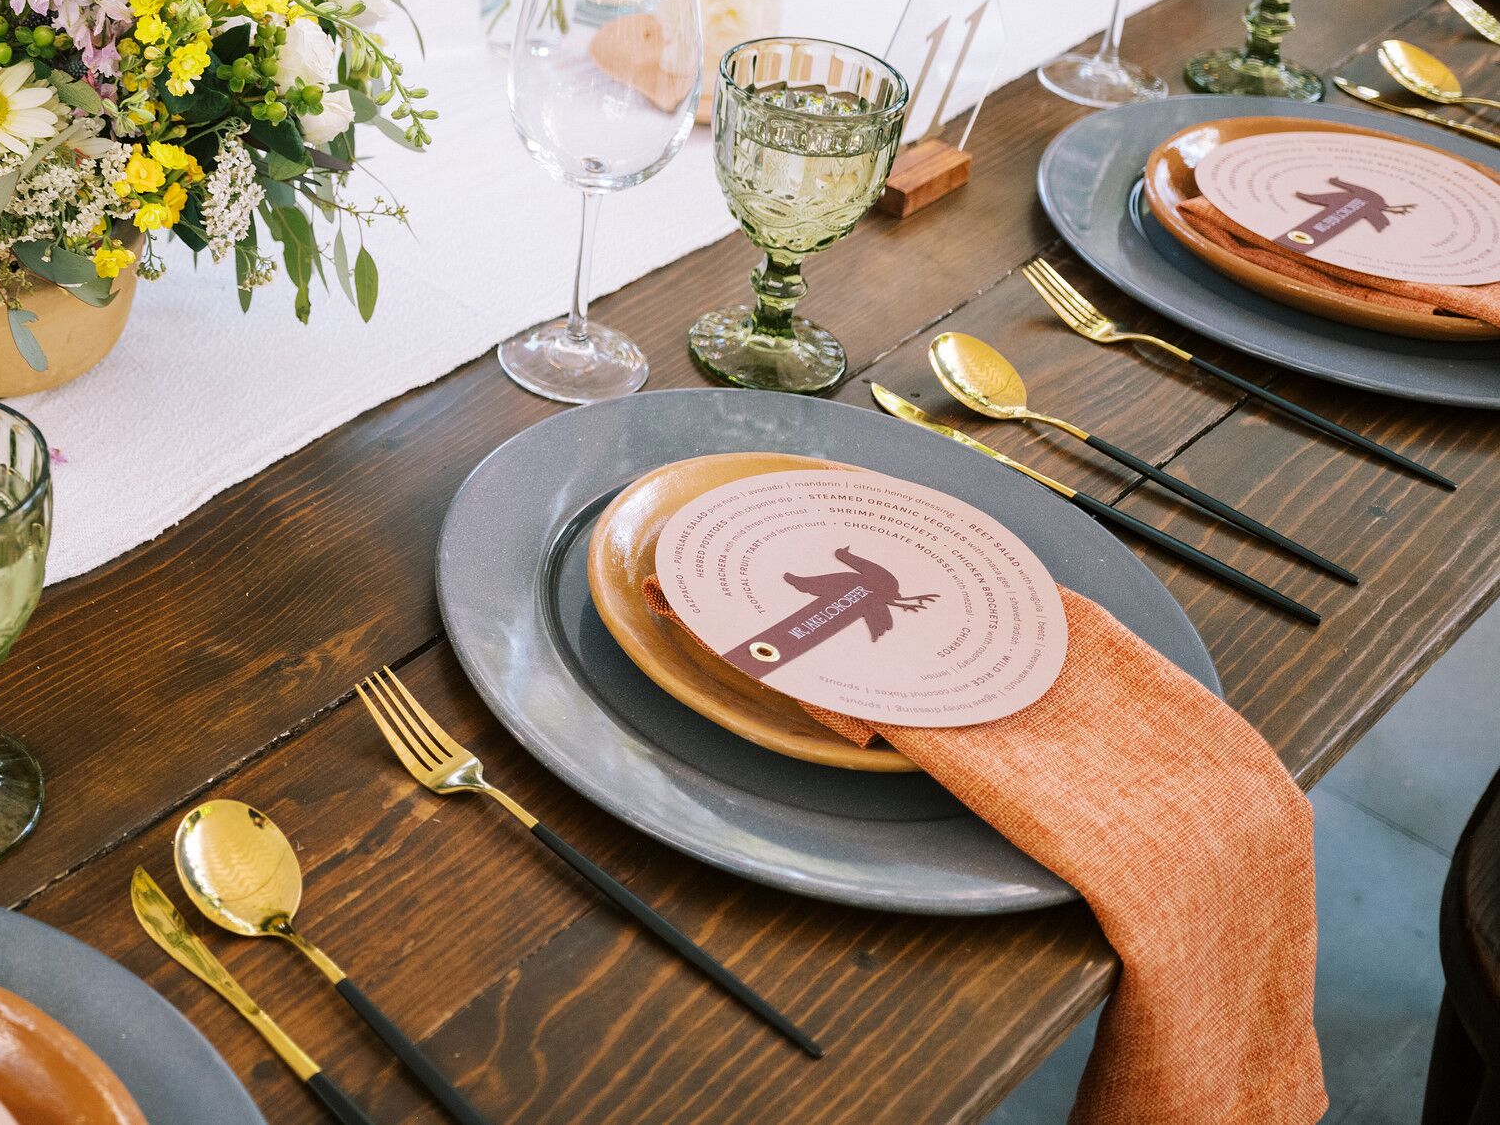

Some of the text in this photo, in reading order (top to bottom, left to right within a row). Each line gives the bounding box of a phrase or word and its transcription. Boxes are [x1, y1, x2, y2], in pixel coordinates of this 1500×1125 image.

[747, 484, 783, 496] avocado
[808, 493, 862, 502] STEAMED
[853, 483, 881, 493] citrus
[884, 488, 913, 502] honey
[722, 494, 740, 505] nuts
[867, 498, 920, 517] ORGANIC
[915, 497, 955, 519] dressing
[687, 511, 708, 530] SALAD
[785, 508, 808, 516] crust
[829, 507, 876, 518] SHRIMP
[804, 520, 827, 529] curd
[844, 521, 913, 544] CHOCOLATE
[879, 514, 939, 542] BROCHETS
[923, 515, 968, 542] VEGGIES
[969, 523, 994, 541] BEET
[700, 519, 728, 550] POTATOES
[673, 530, 691, 564] PURSLANE
[745, 539, 764, 555] TART
[993, 542, 1020, 567] SALAD
[695, 550, 706, 578] HERBED
[739, 555, 751, 576] FRUIT
[915, 543, 956, 575] MOUSSE
[951, 549, 987, 584] CHICKEN
[717, 554, 732, 597] ARRACHERA
[675, 574, 701, 614] GAZPACHO
[741, 577, 766, 615] TROPICAL
[982, 586, 999, 630] BROCHETS
[801, 613, 828, 633] JAKE
[1037, 620, 1046, 641] beets
[936, 627, 971, 659] CHURROS
[992, 655, 1012, 673] WILD
[819, 675, 860, 691] sprouts
[920, 668, 951, 681] lemon
[971, 672, 994, 687] RICE
[839, 695, 882, 709] sprouts
[911, 688, 950, 698] coconut
[894, 704, 941, 714] dressing
